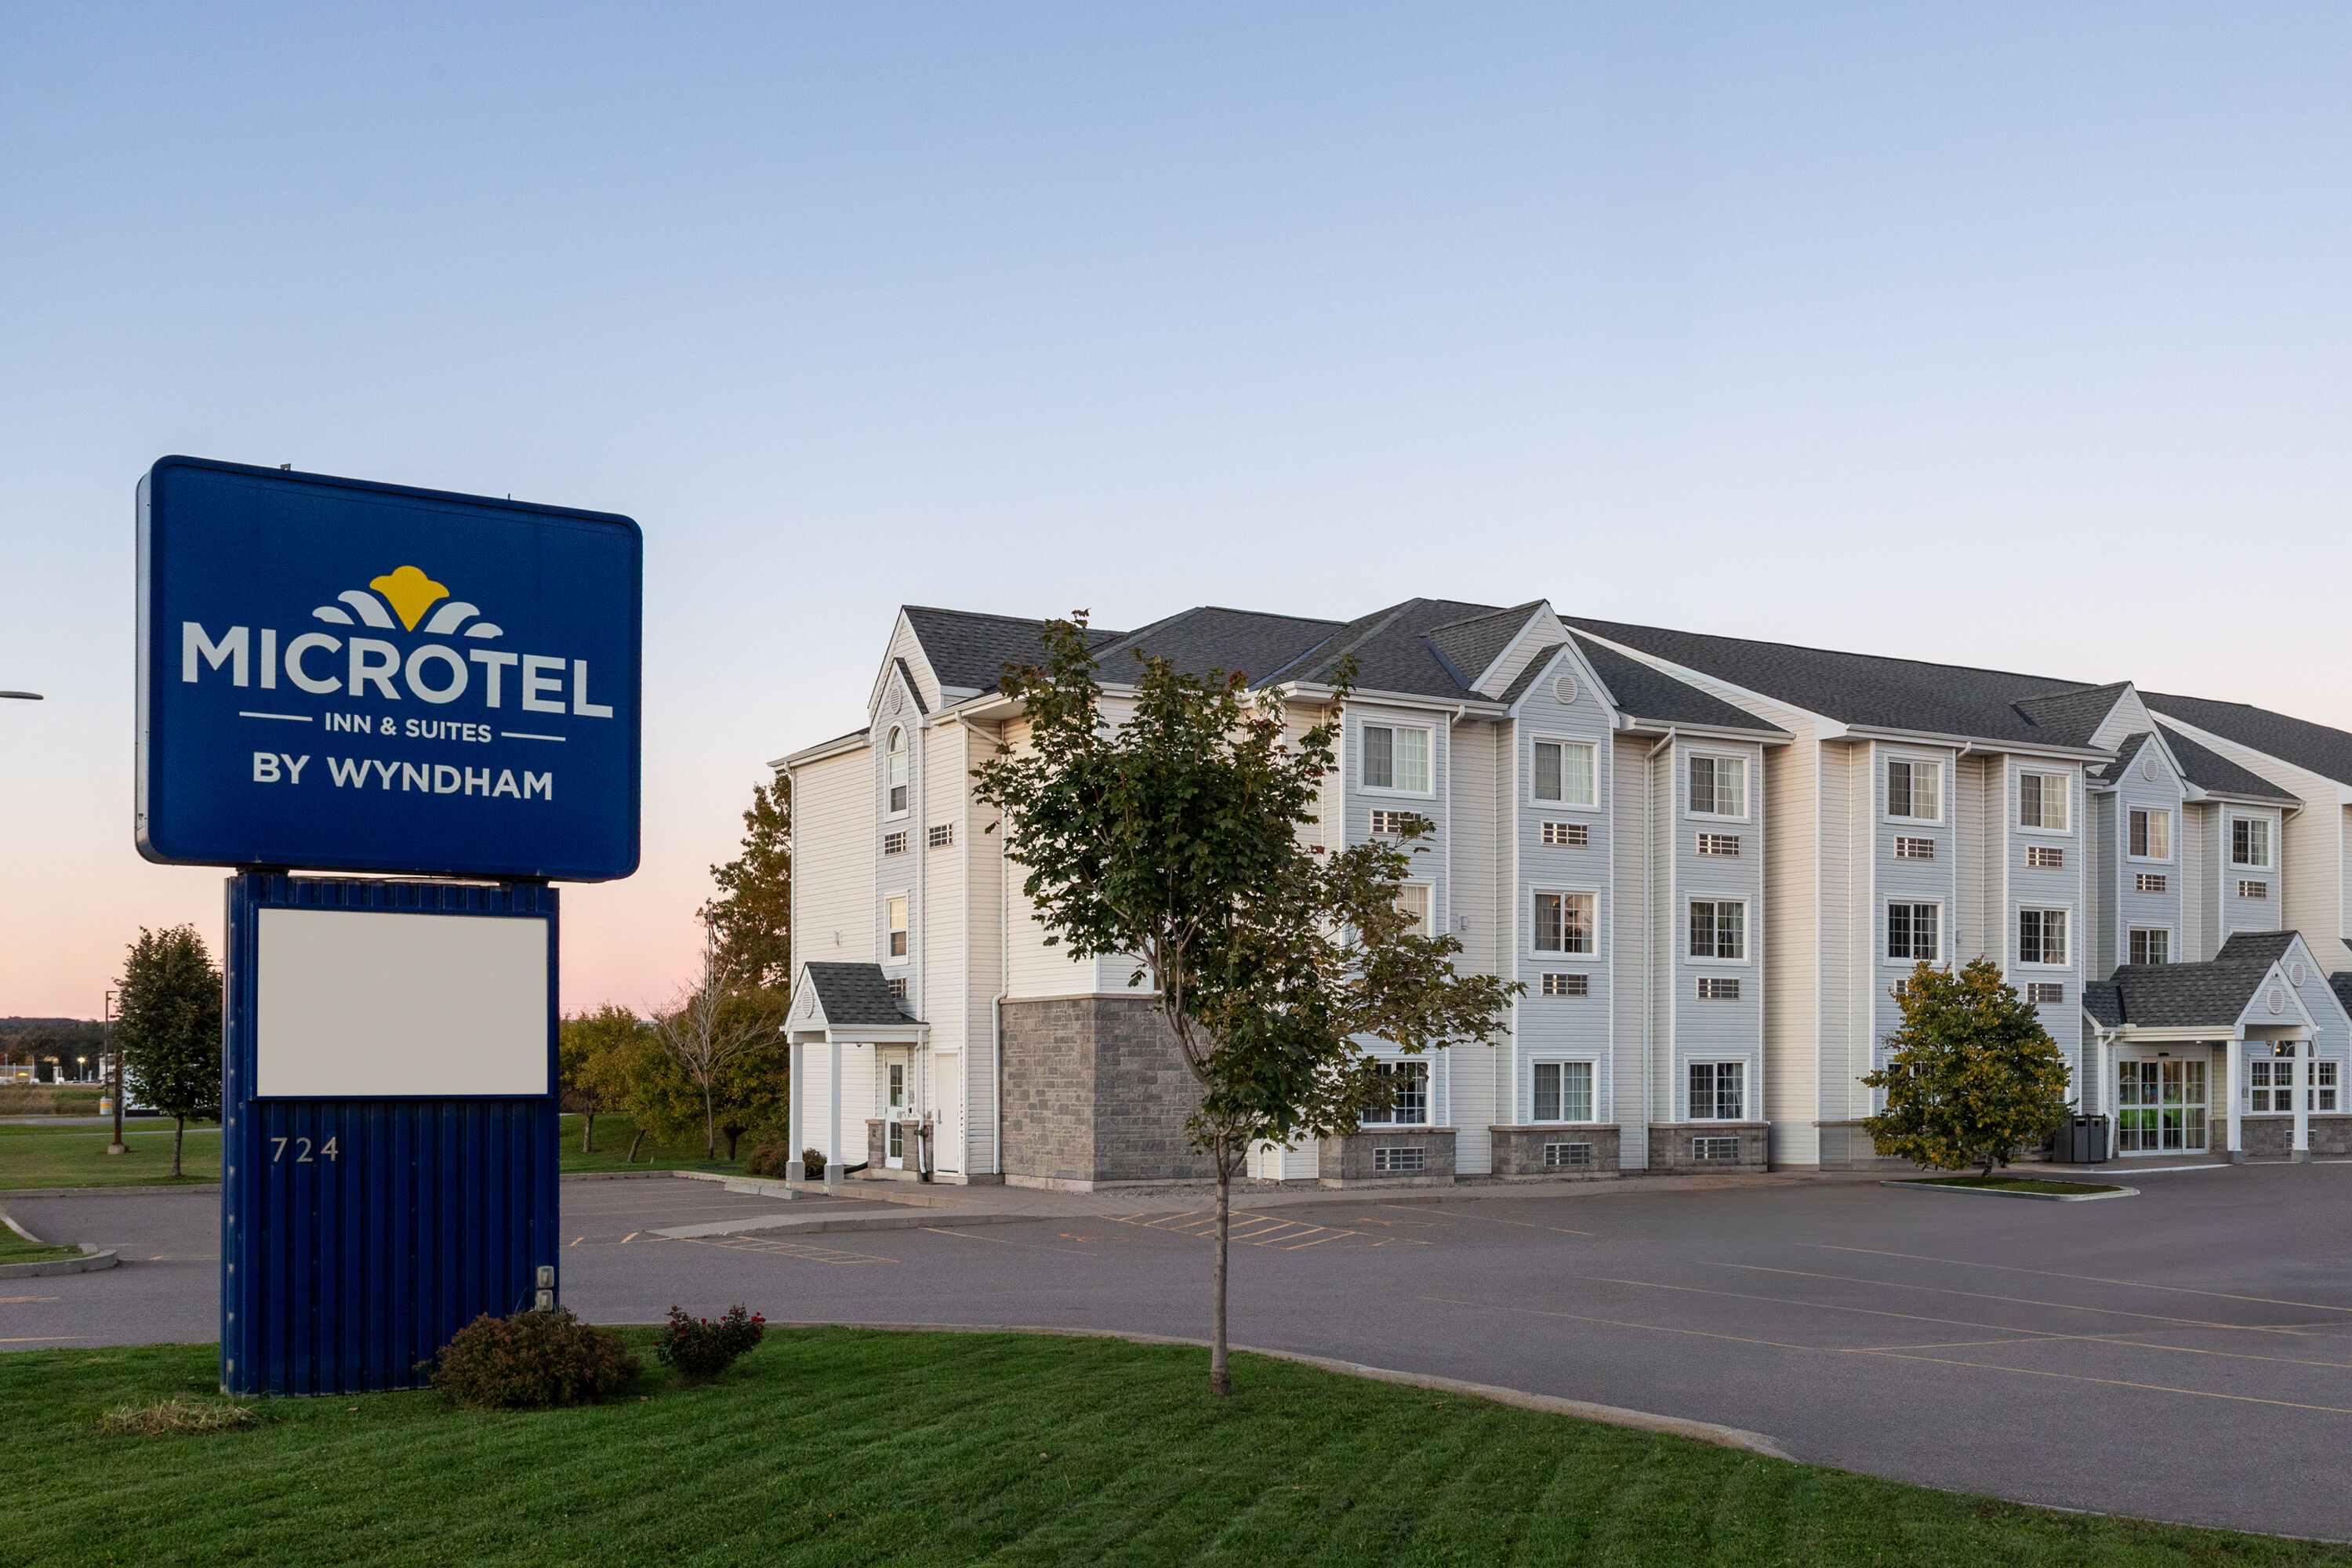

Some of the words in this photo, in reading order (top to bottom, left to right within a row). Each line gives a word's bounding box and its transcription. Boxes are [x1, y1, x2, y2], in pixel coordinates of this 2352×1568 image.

[182, 621, 613, 719] MICROTEL
[325, 712, 371, 734] INN
[379, 717, 397, 735] &
[405, 718, 492, 743] SUITES
[253, 752, 310, 785] BY
[326, 757, 553, 800] WYNDHAM
[270, 1136, 339, 1162] 724
